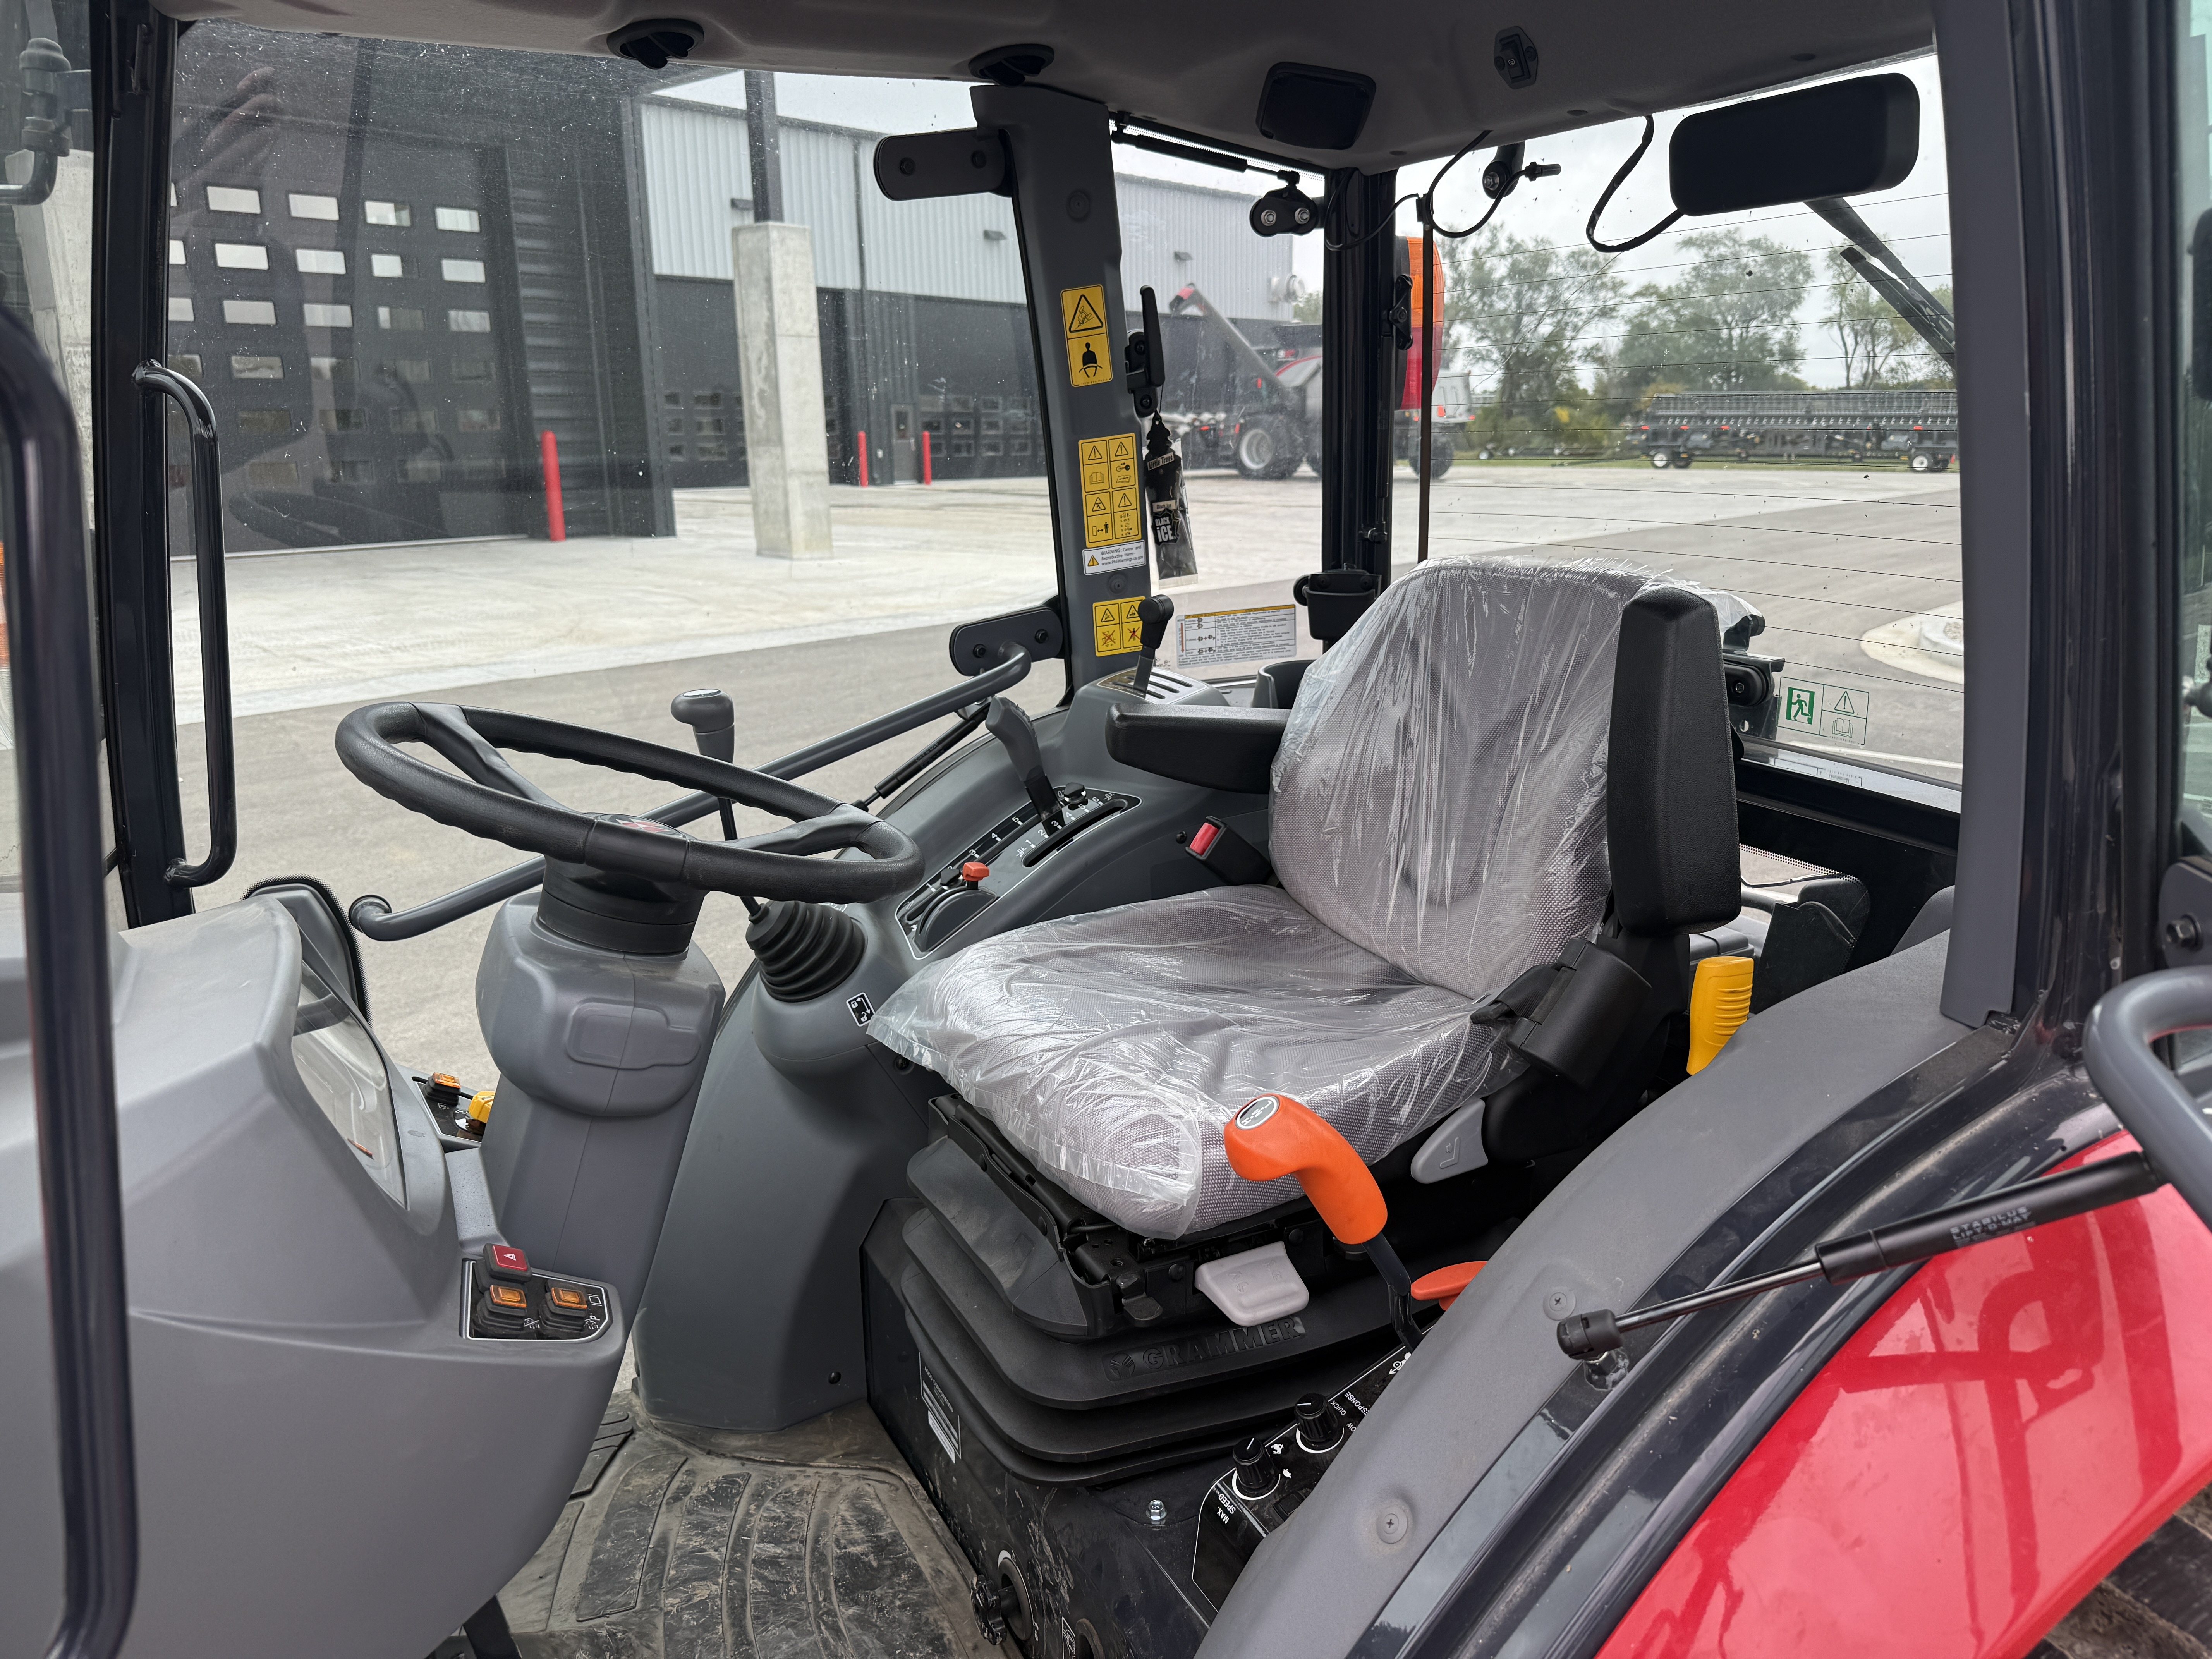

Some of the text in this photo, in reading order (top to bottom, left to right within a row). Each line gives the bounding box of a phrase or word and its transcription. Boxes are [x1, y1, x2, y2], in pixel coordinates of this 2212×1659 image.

[1155, 517, 1170, 526] BLACK
[1949, 1207, 2028, 1234] STABILUS
[1143, 1317, 1301, 1370] GRAMMER
[1330, 1400, 1346, 1415] QUICK
[1218, 1493, 1236, 1514] SPEED
[1217, 1506, 1229, 1524] MAX.
